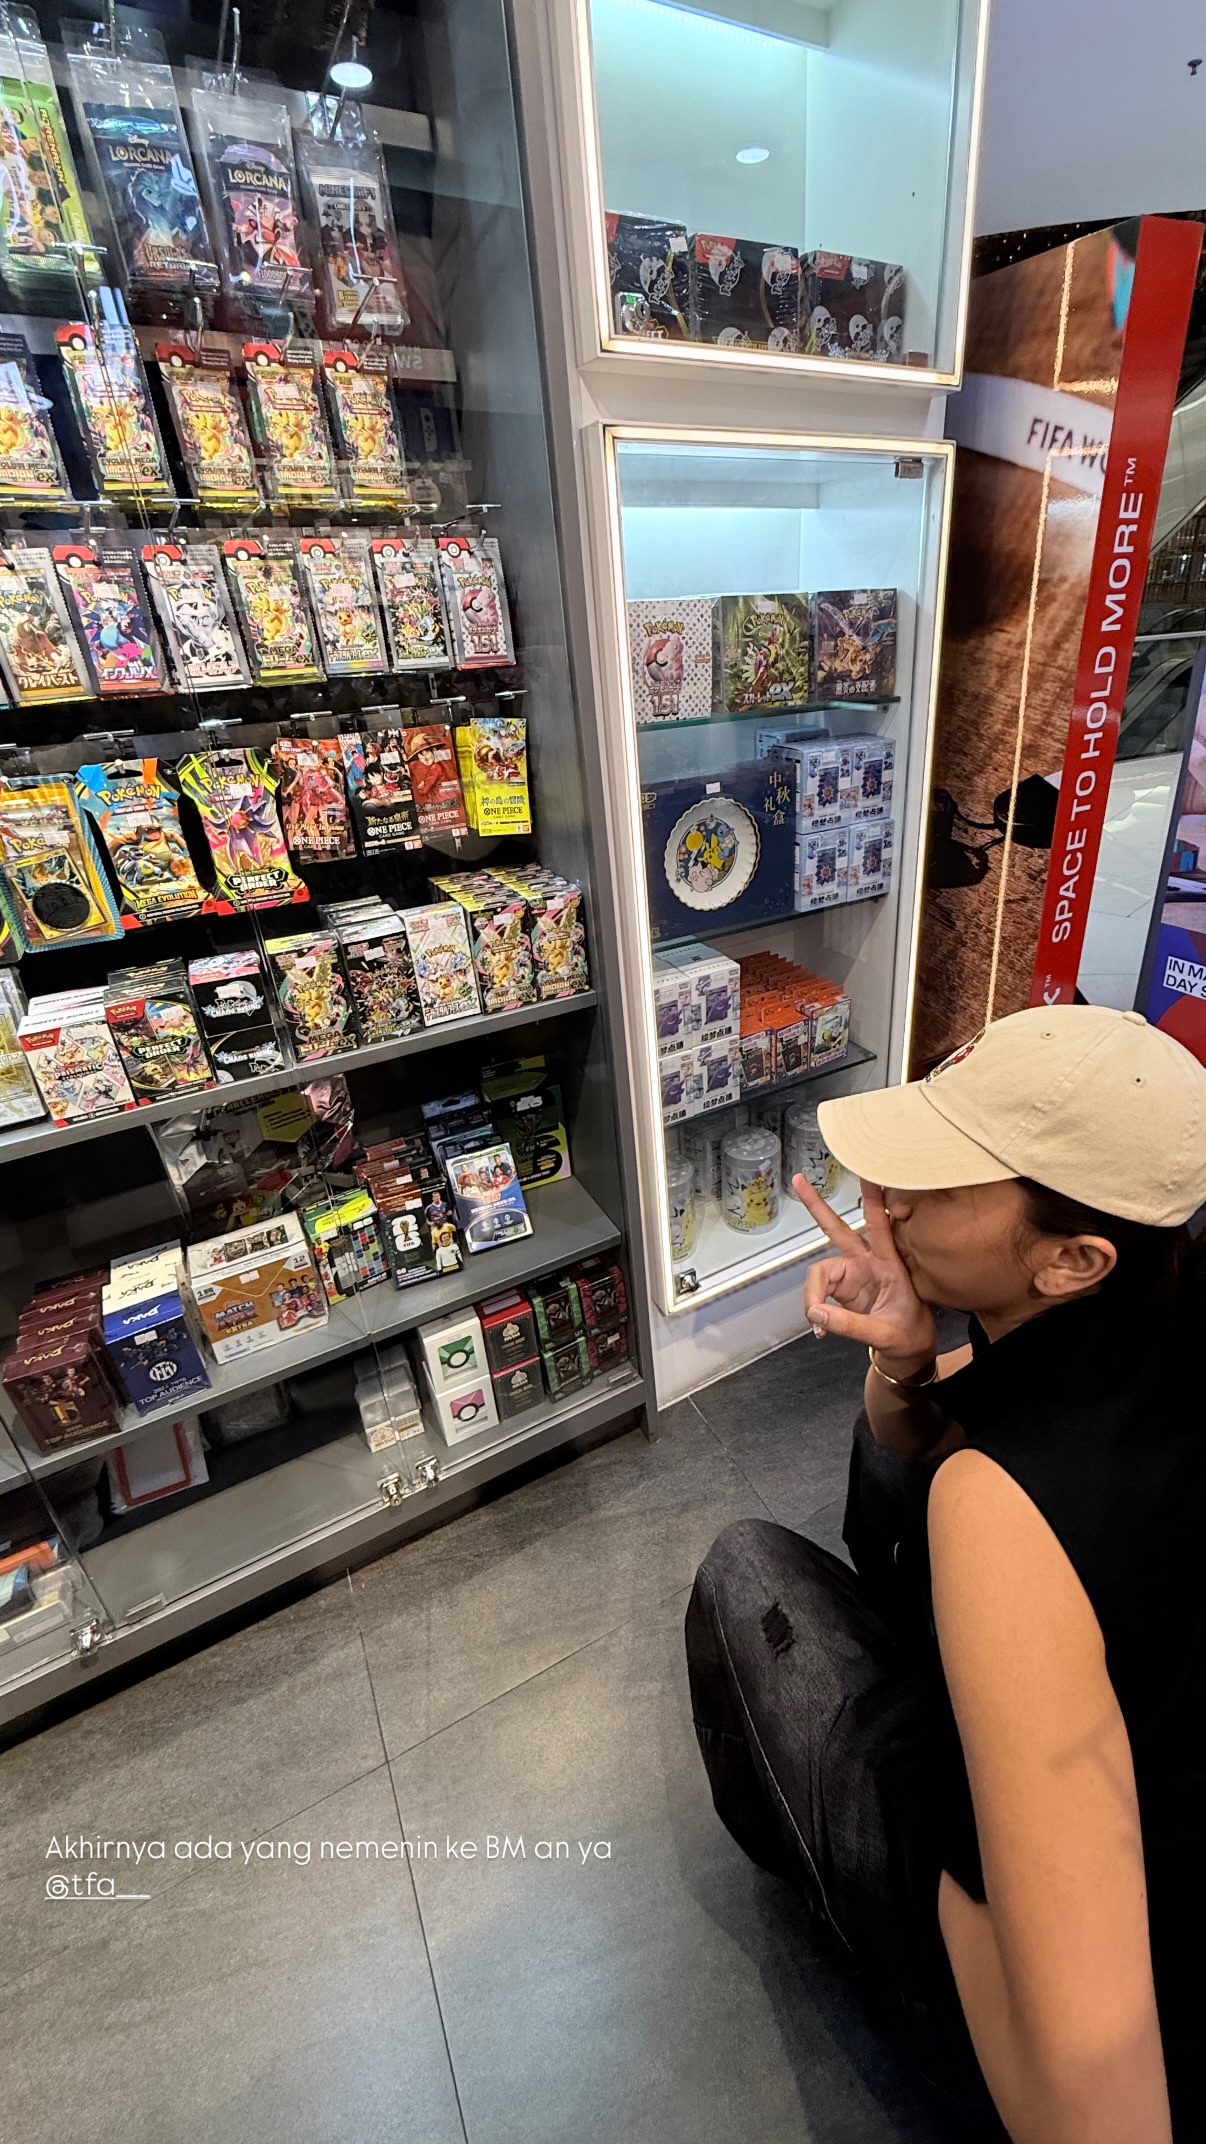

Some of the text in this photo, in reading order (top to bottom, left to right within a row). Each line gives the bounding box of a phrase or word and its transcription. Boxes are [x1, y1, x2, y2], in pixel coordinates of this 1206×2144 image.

[108, 145, 172, 164] LORCANA
[227, 166, 288, 191] LORCANA
[1027, 416, 1074, 460] FIFA
[648, 693, 680, 717] 151
[1080, 646, 1117, 761] HOLD
[1070, 768, 1097, 823] TO
[418, 810, 459, 824] ONE PIECE
[483, 806, 523, 815] ONE PIECE
[366, 821, 413, 837] ONE PIECE
[293, 836, 340, 846] ONE PIECE
[232, 870, 280, 885] PERFECT
[239, 879, 278, 893] ORDER
[1051, 827, 1089, 945] SPACE
[136, 889, 198, 910] MEGA EVOLUTION
[1168, 958, 1185, 975] IN
[1165, 973, 1199, 994] DAY
[210, 1007, 238, 1018] CHAOS
[137, 1037, 183, 1055] PERFECT
[145, 1046, 182, 1060] ORDER
[223, 1055, 248, 1065] CHAOS
[54, 1063, 104, 1080] PRISMATIC
[293, 1255, 306, 1264] 12
[123, 1303, 161, 1325] DAKA
[214, 1300, 256, 1320] MATCH
[139, 1375, 203, 1405] TOP AUDIENCE
